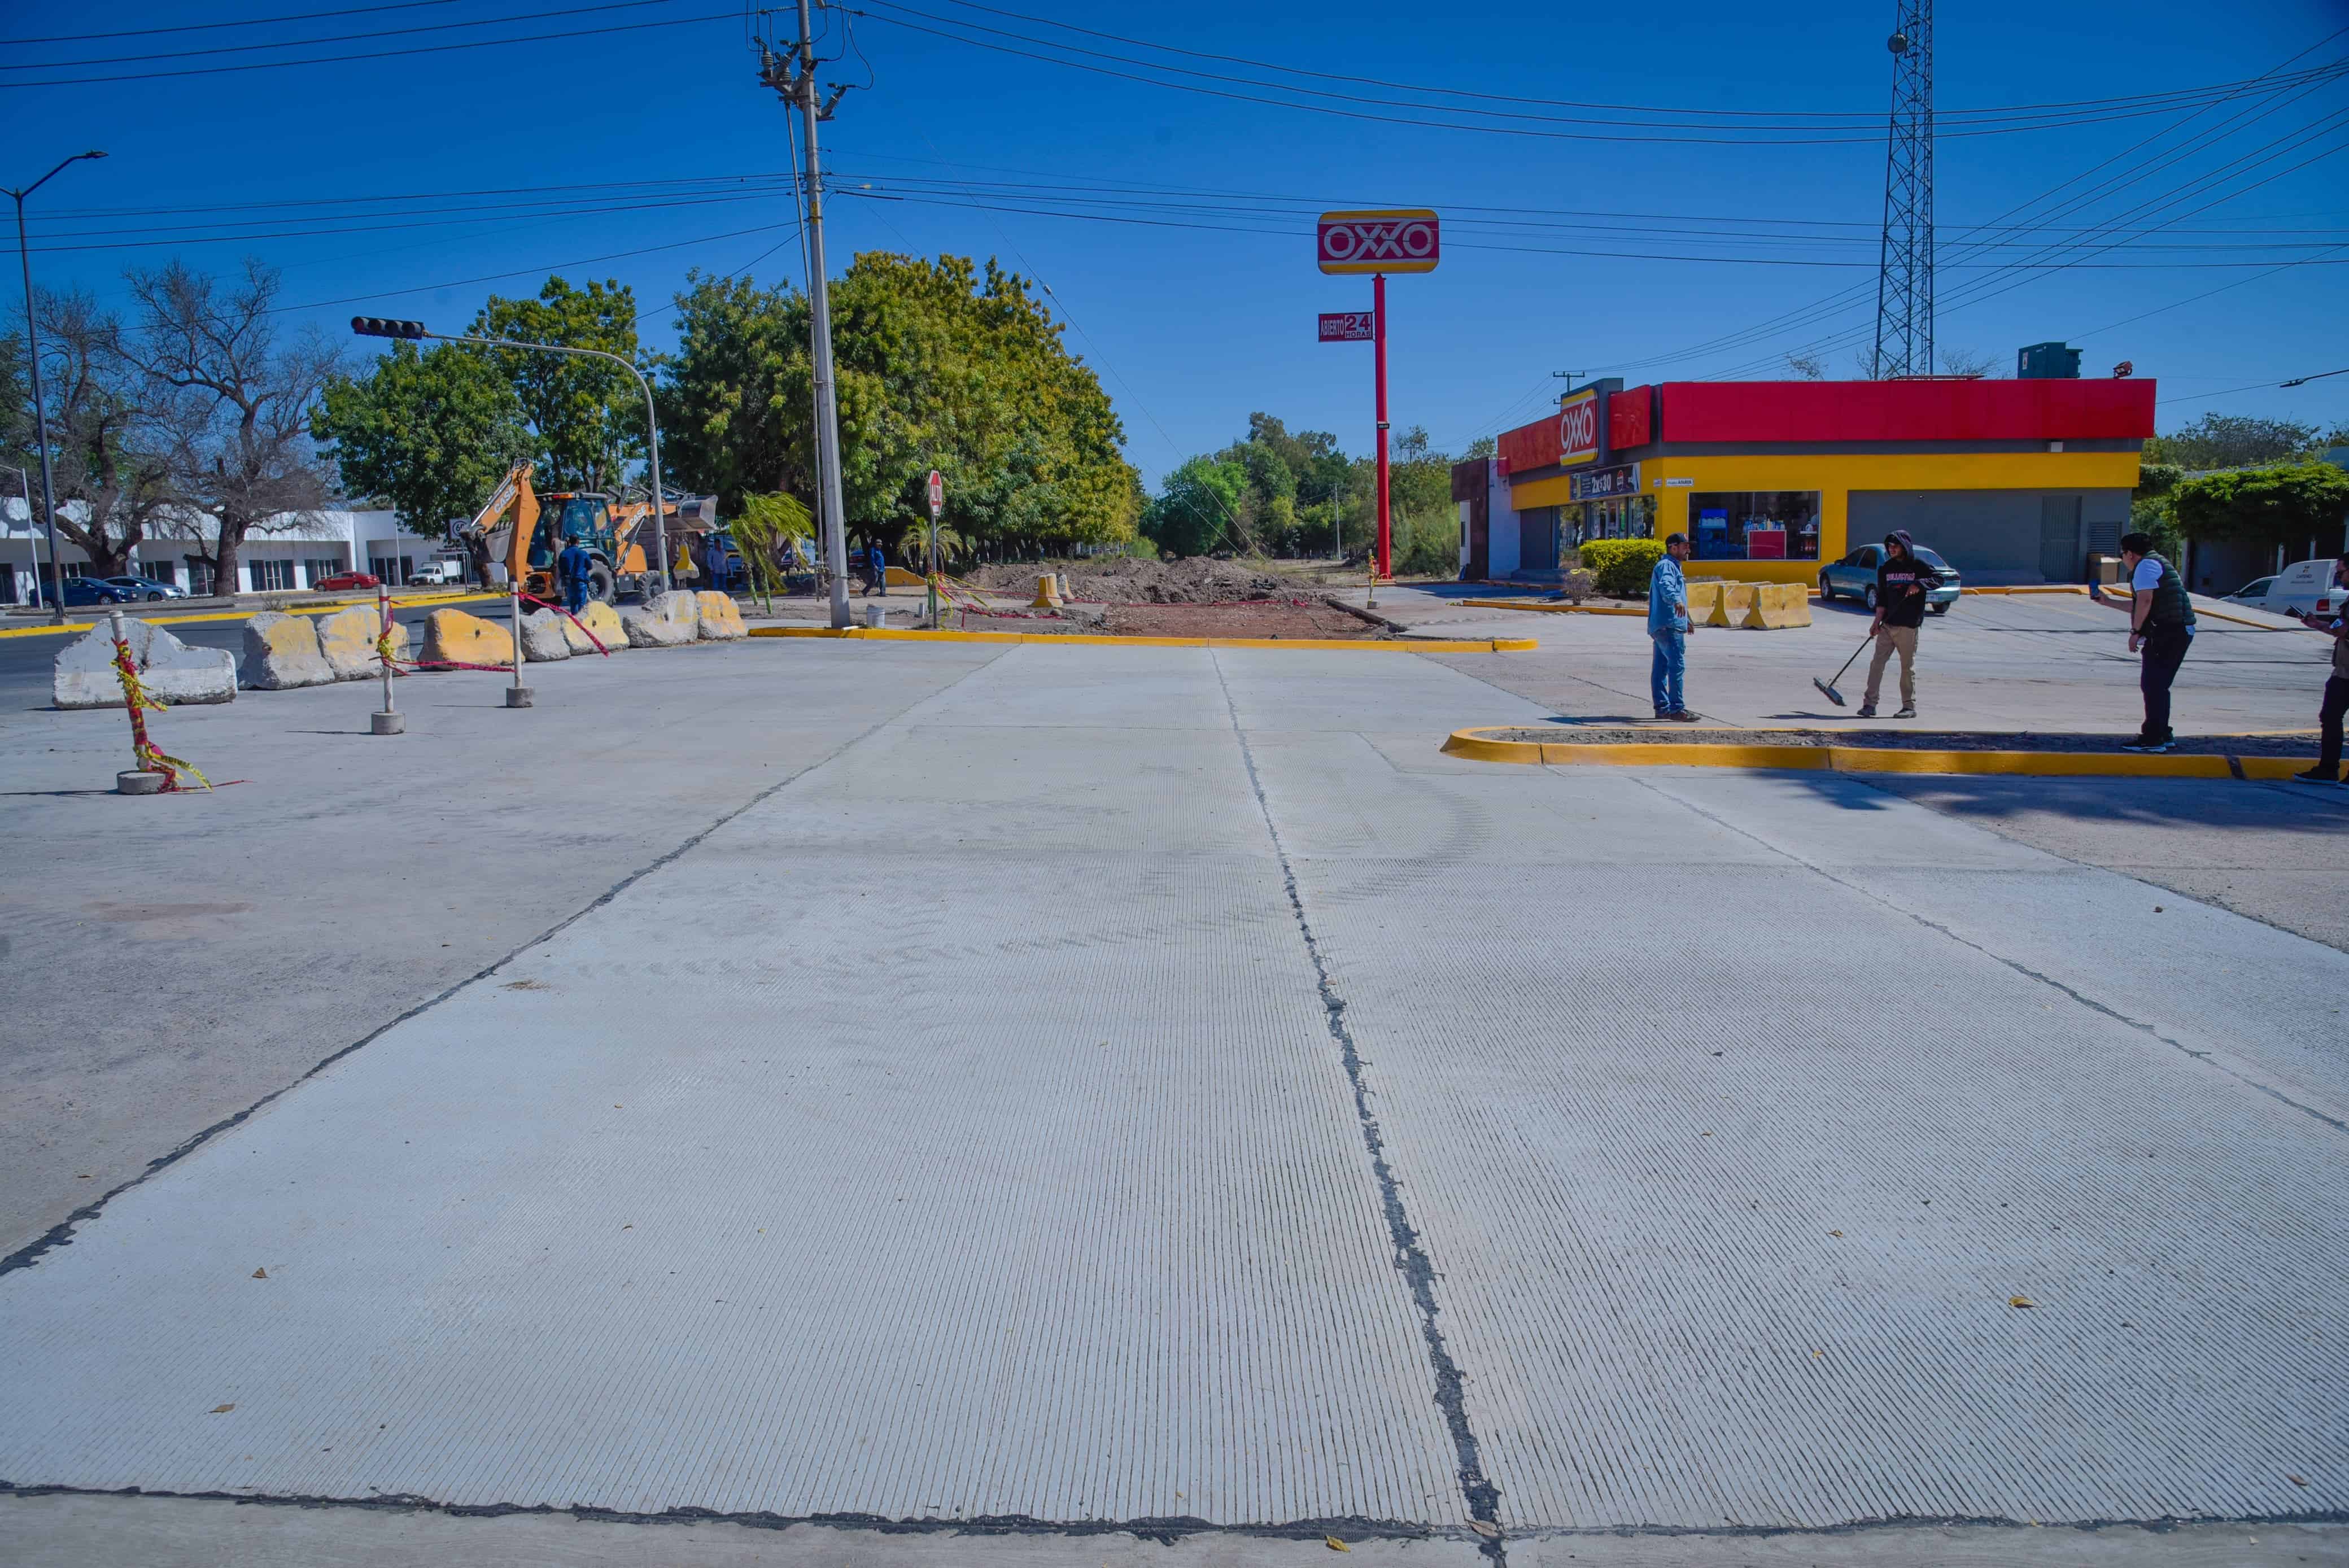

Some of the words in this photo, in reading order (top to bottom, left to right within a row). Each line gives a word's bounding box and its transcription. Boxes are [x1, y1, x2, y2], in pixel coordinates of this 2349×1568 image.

[1324, 224, 1433, 259] OXXO
[1321, 319, 1344, 336] ABIERTO
[1346, 314, 1371, 331] 24
[1561, 405, 1592, 452] OXXO
[494, 483, 516, 514] CASE
[931, 484, 941, 502] ALTO
[628, 505, 647, 527] CASE
